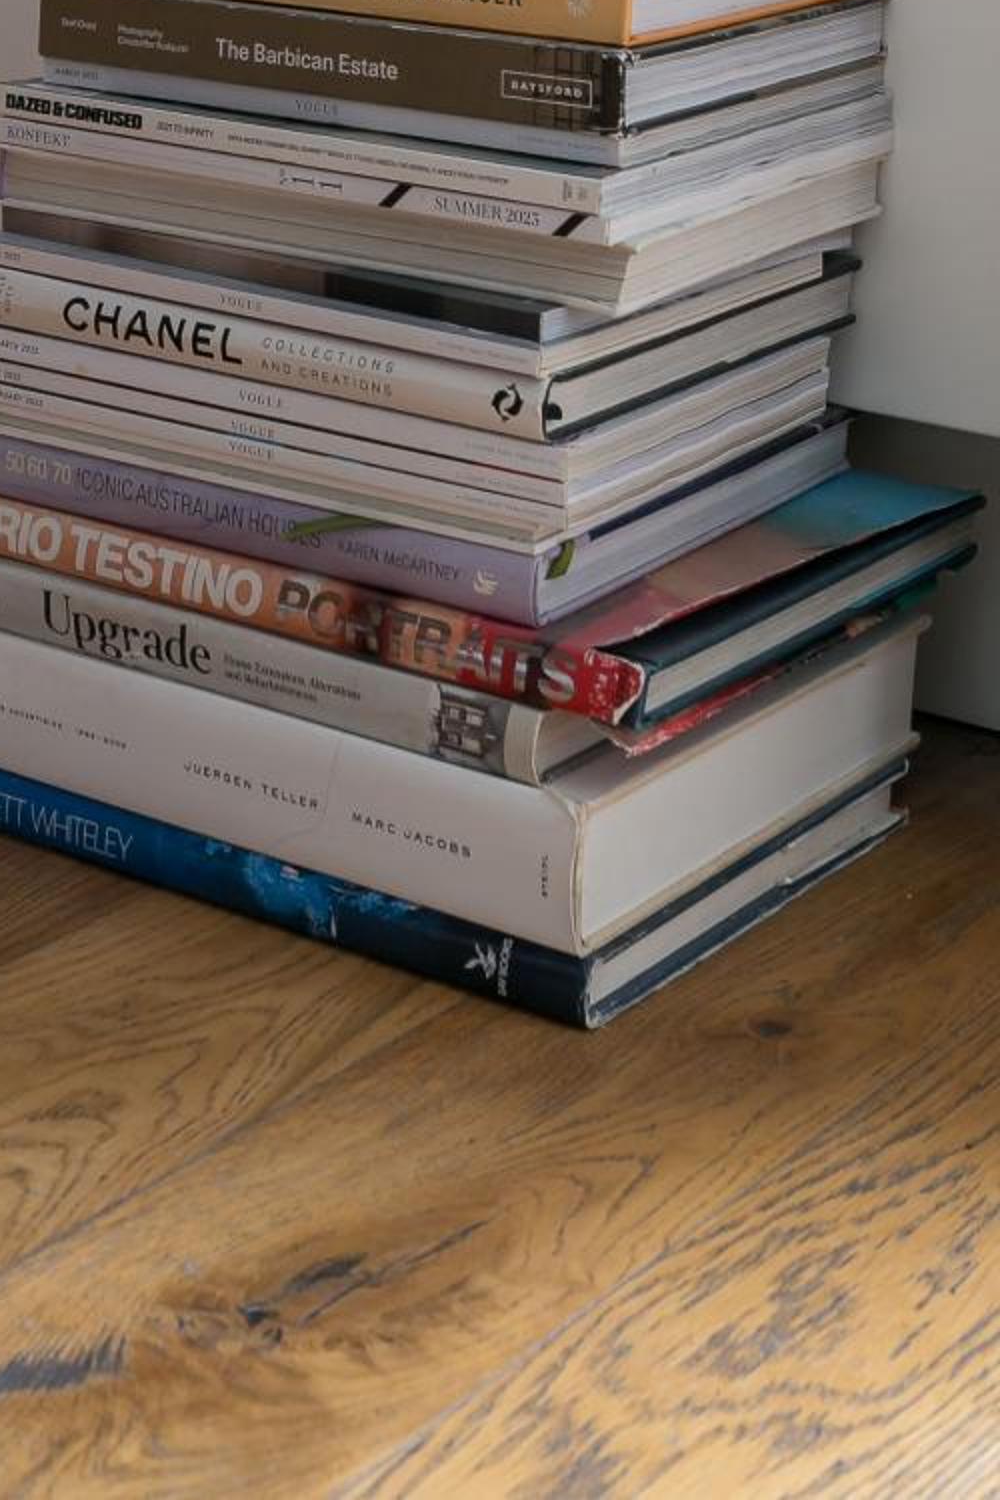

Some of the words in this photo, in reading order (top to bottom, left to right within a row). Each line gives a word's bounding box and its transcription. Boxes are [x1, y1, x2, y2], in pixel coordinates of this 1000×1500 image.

[215, 37, 249, 62] The
[254, 43, 333, 73] Barbican
[338, 53, 399, 80] Estate
[5, 93, 51, 116] DAZED
[53, 102, 62, 116] &
[65, 103, 143, 130] CONFUSED
[510, 80, 583, 99] BATSFORD
[432, 196, 502, 221] SUMMER
[62, 297, 243, 365] CHANEL
[263, 336, 395, 374] COLLECTIONS
[261, 360, 291, 376] AND
[299, 368, 393, 397] CREATIONS
[135, 482, 244, 527] AUSTRALIAN
[42, 589, 212, 676] Upgrade
[71, 524, 264, 618] TESTINO
[278, 577, 576, 703] PORTRAITS
[183, 761, 251, 790] JUERGEN
[262, 783, 319, 811] TELLER
[30, 801, 135, 863] WHITELEY
[351, 810, 396, 836] MARC
[402, 829, 472, 859] JACOBS
